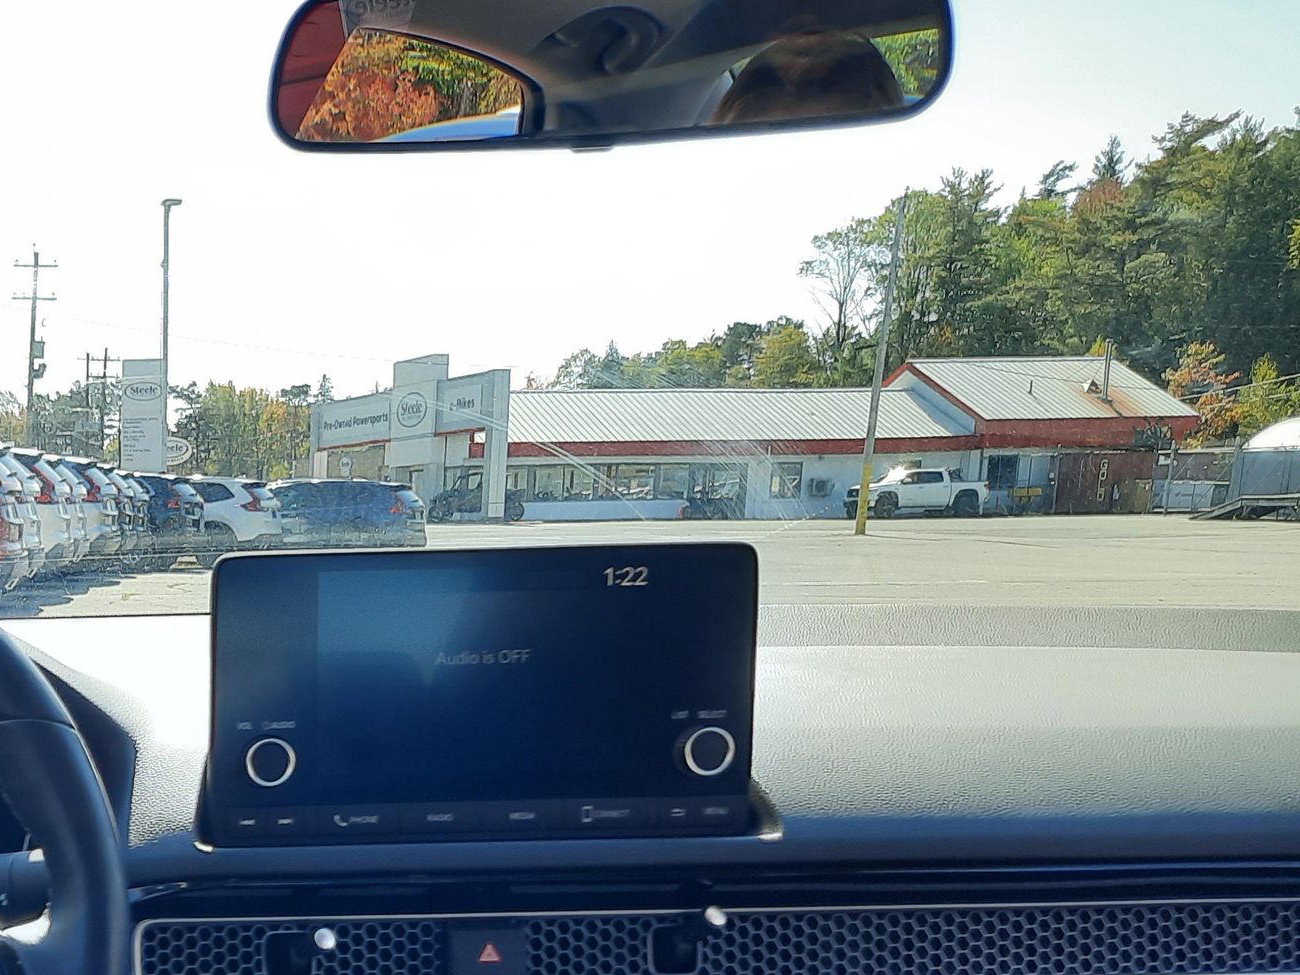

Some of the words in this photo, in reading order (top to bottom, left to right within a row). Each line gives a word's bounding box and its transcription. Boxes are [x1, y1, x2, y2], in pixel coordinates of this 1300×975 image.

[129, 386, 158, 395] Steele
[400, 401, 423, 416] Steele
[353, 412, 388, 427] Powersports
[604, 566, 648, 586] 1:22
[436, 651, 480, 665] Audio
[482, 651, 495, 664] is
[498, 649, 532, 664] OFF
